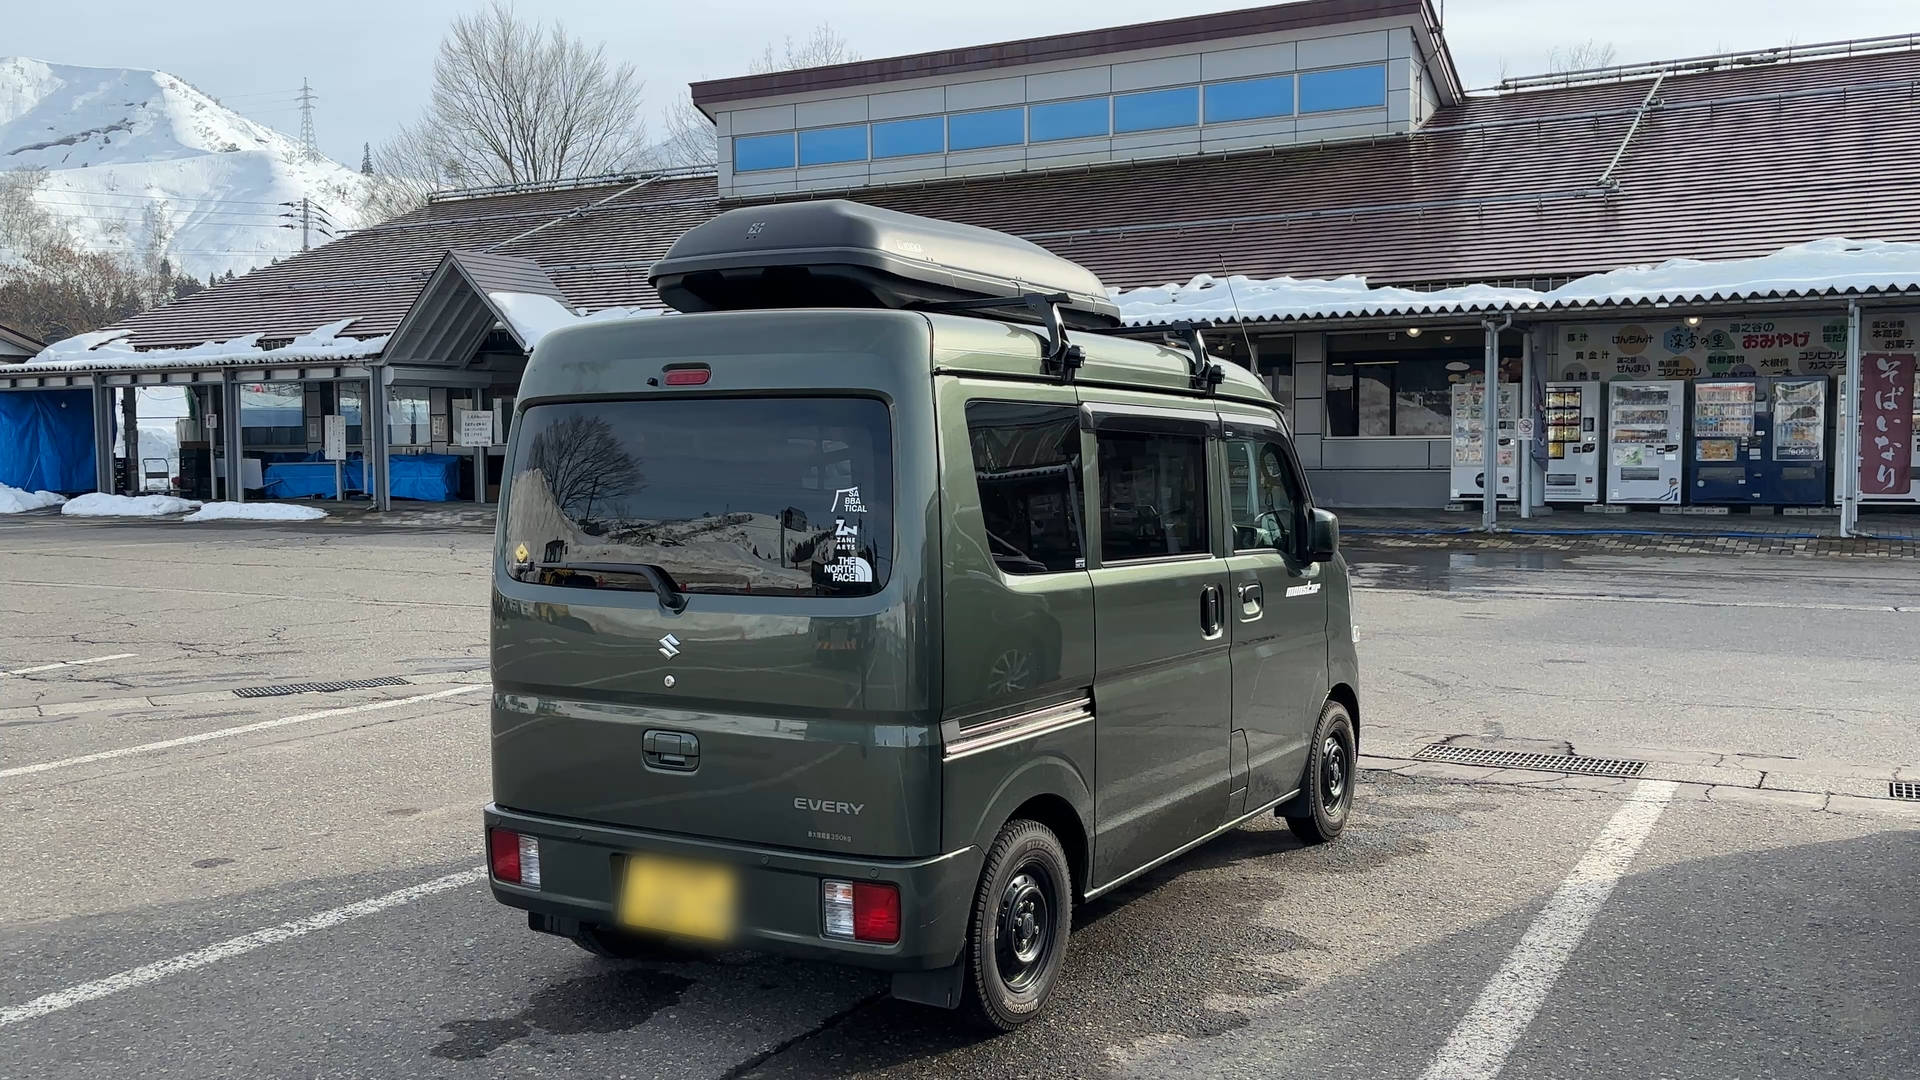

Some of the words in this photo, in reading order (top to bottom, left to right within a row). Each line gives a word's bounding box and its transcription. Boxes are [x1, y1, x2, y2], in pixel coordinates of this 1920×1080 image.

[1611, 334, 1654, 345] けんちん汁
[1742, 331, 1810, 349] おみやげ
[1658, 368, 1702, 377] コシヒカリ
[1875, 357, 1905, 491] そばいなり
[845, 497, 861, 505] BBA
[838, 556, 856, 566] THE
[824, 564, 856, 574] NORTH
[832, 573, 856, 582] FACE
[793, 797, 864, 815] EVERY
